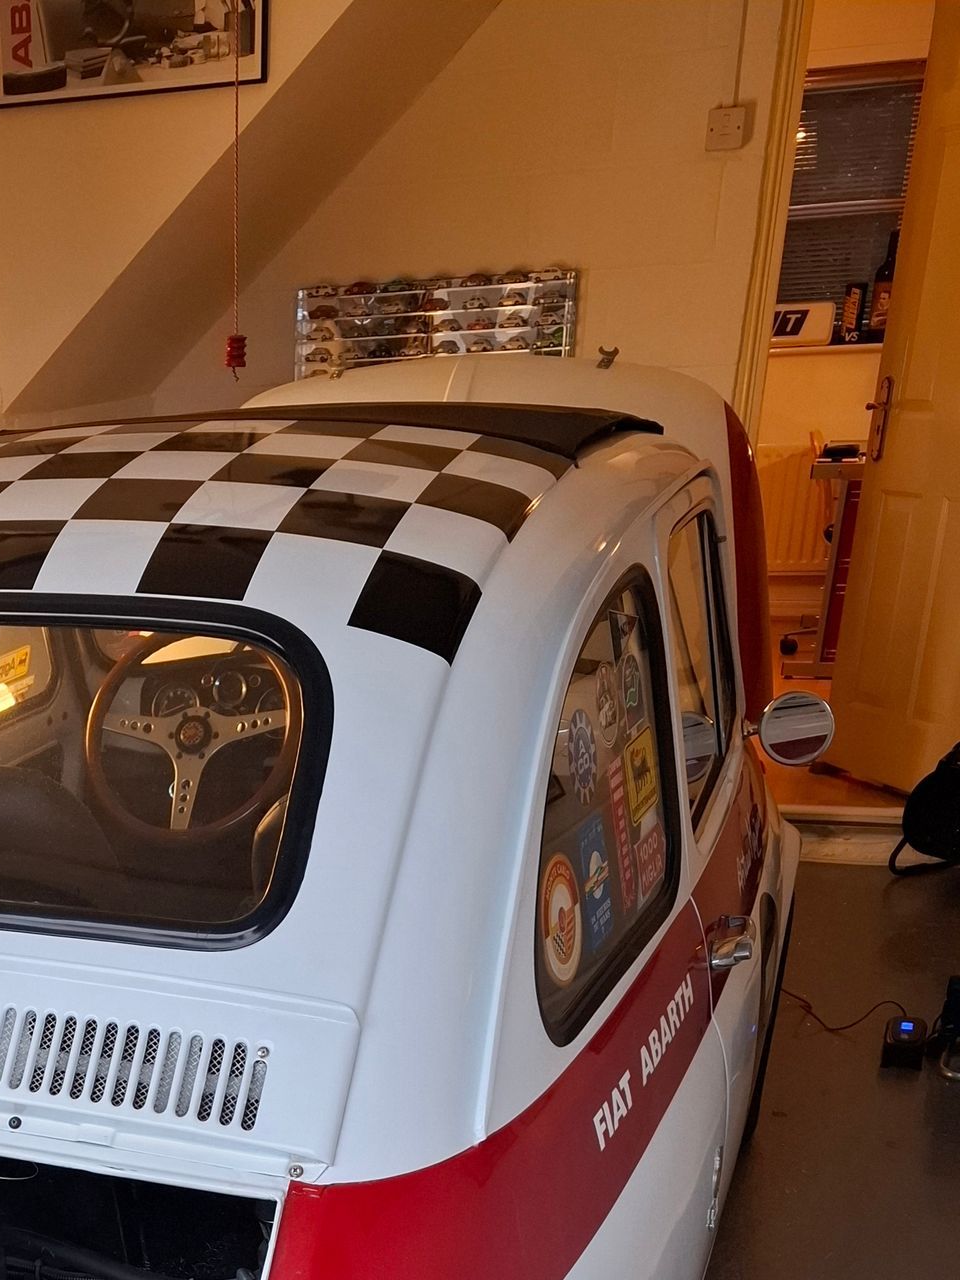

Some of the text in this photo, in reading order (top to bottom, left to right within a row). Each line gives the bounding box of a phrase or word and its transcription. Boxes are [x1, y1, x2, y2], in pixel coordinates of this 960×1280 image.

[10, 0, 33, 68] AB
[785, 313, 802, 332] T
[844, 332, 860, 342] VS
[577, 753, 590, 774] CO
[640, 831, 658, 863] 1000
[592, 972, 695, 1152] FIAT ABARTH
